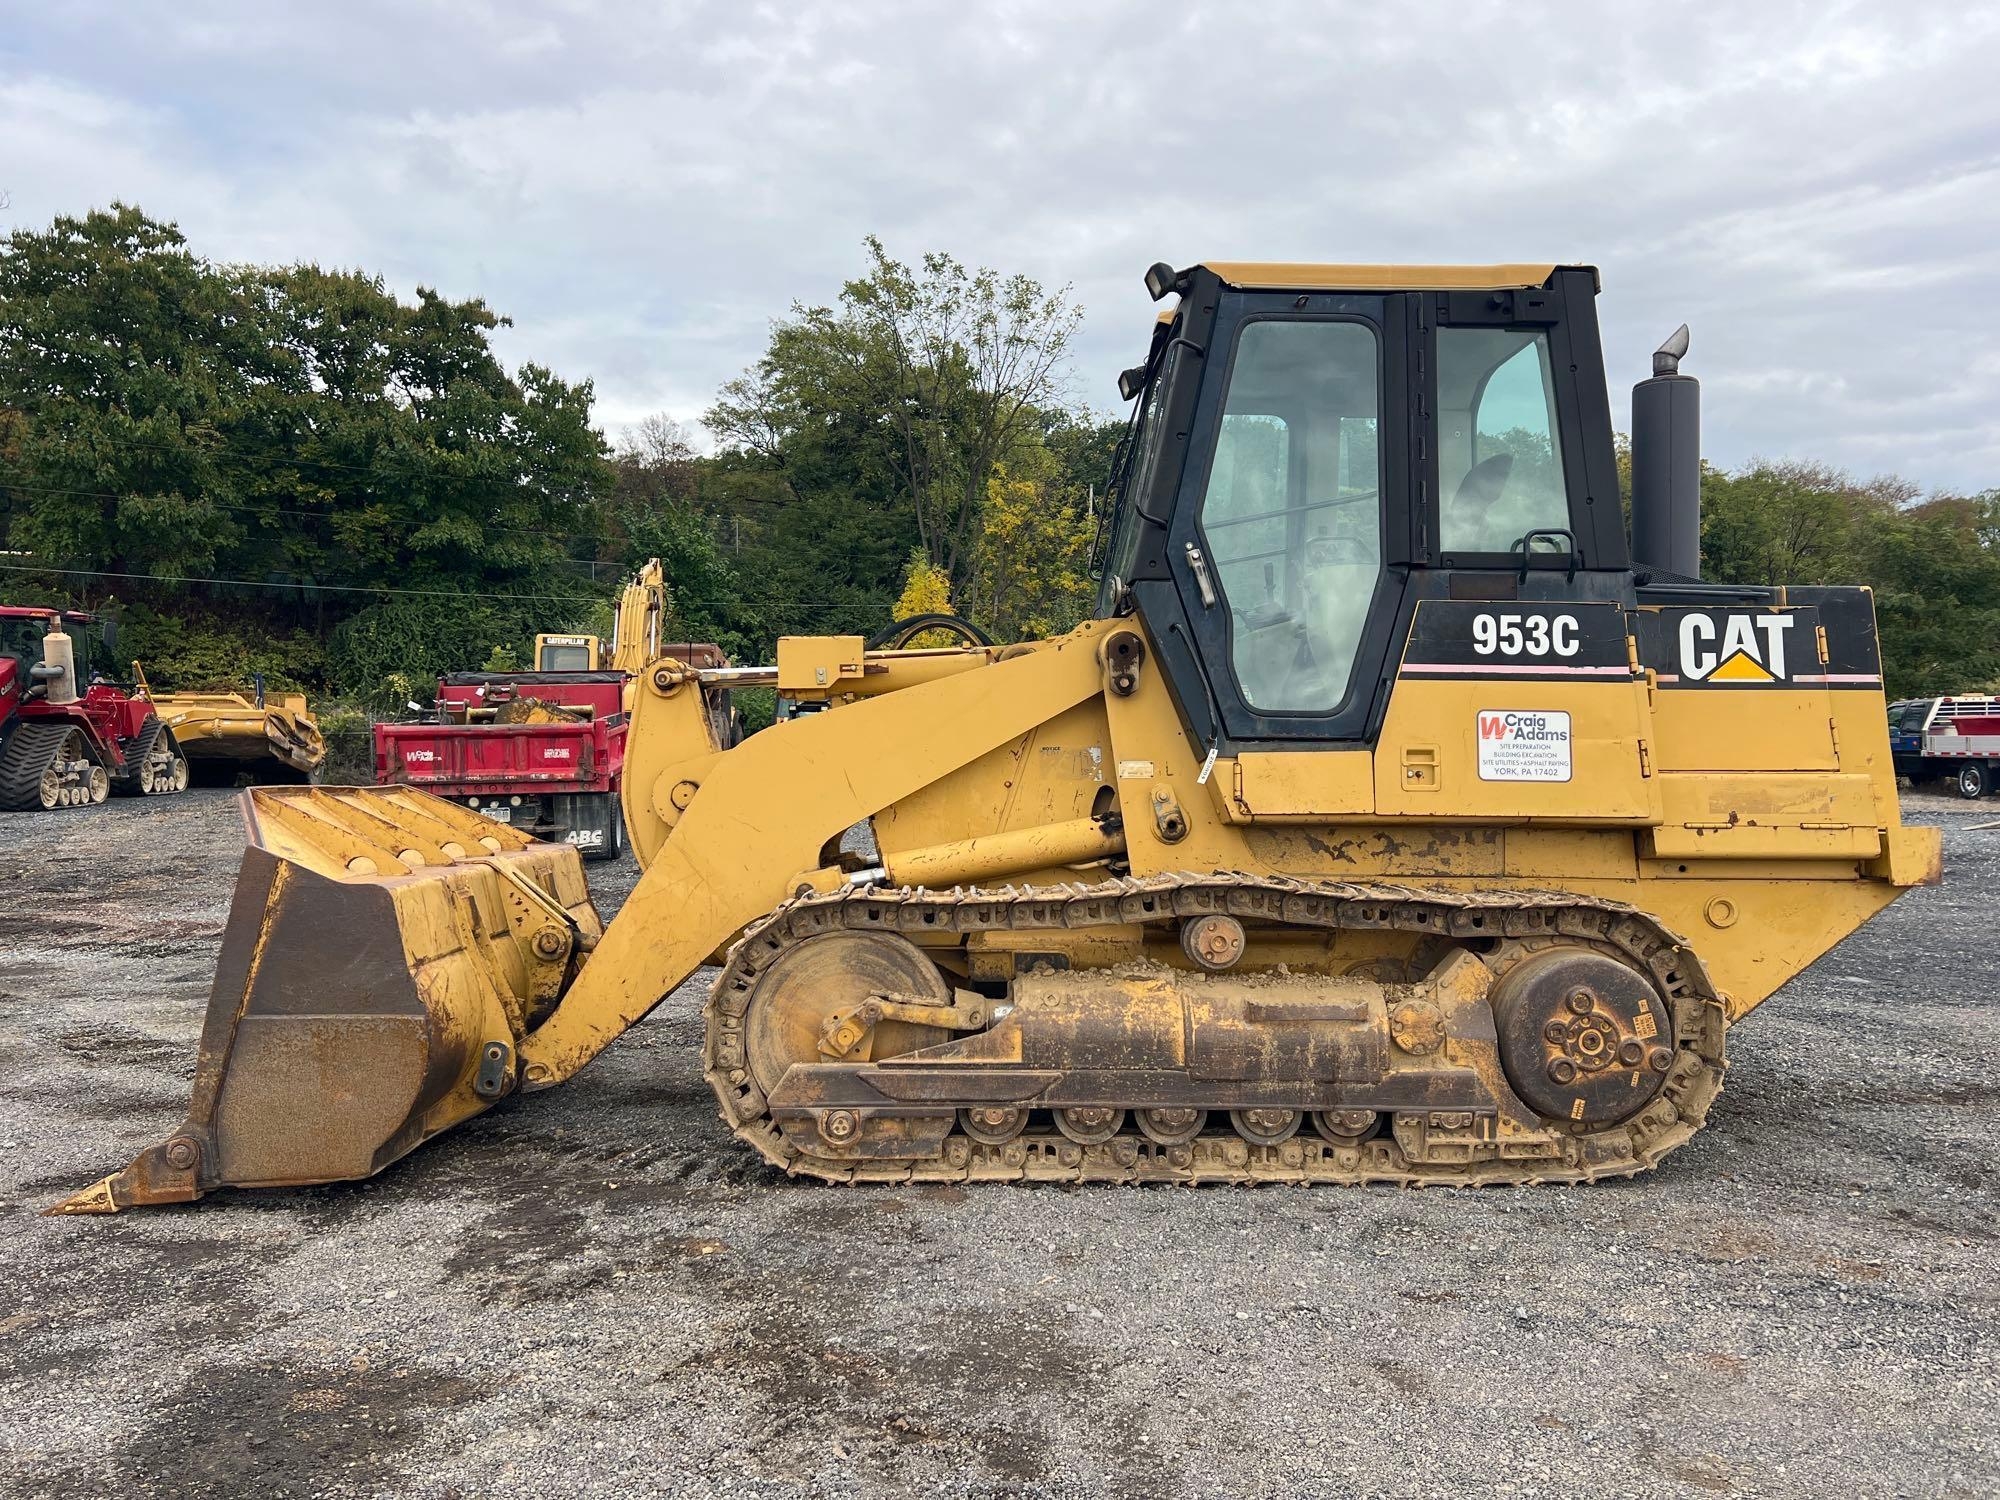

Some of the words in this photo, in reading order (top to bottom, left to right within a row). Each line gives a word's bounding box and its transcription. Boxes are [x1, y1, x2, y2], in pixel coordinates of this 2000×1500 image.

[1473, 614, 1579, 656] 953C
[1679, 613, 1794, 680] CAT
[1505, 714, 1546, 731] Craig
[1514, 727, 1567, 740] Adams
[1494, 767, 1519, 776] YORK,
[1521, 768, 1532, 776] PA
[1535, 768, 1558, 776] 17402
